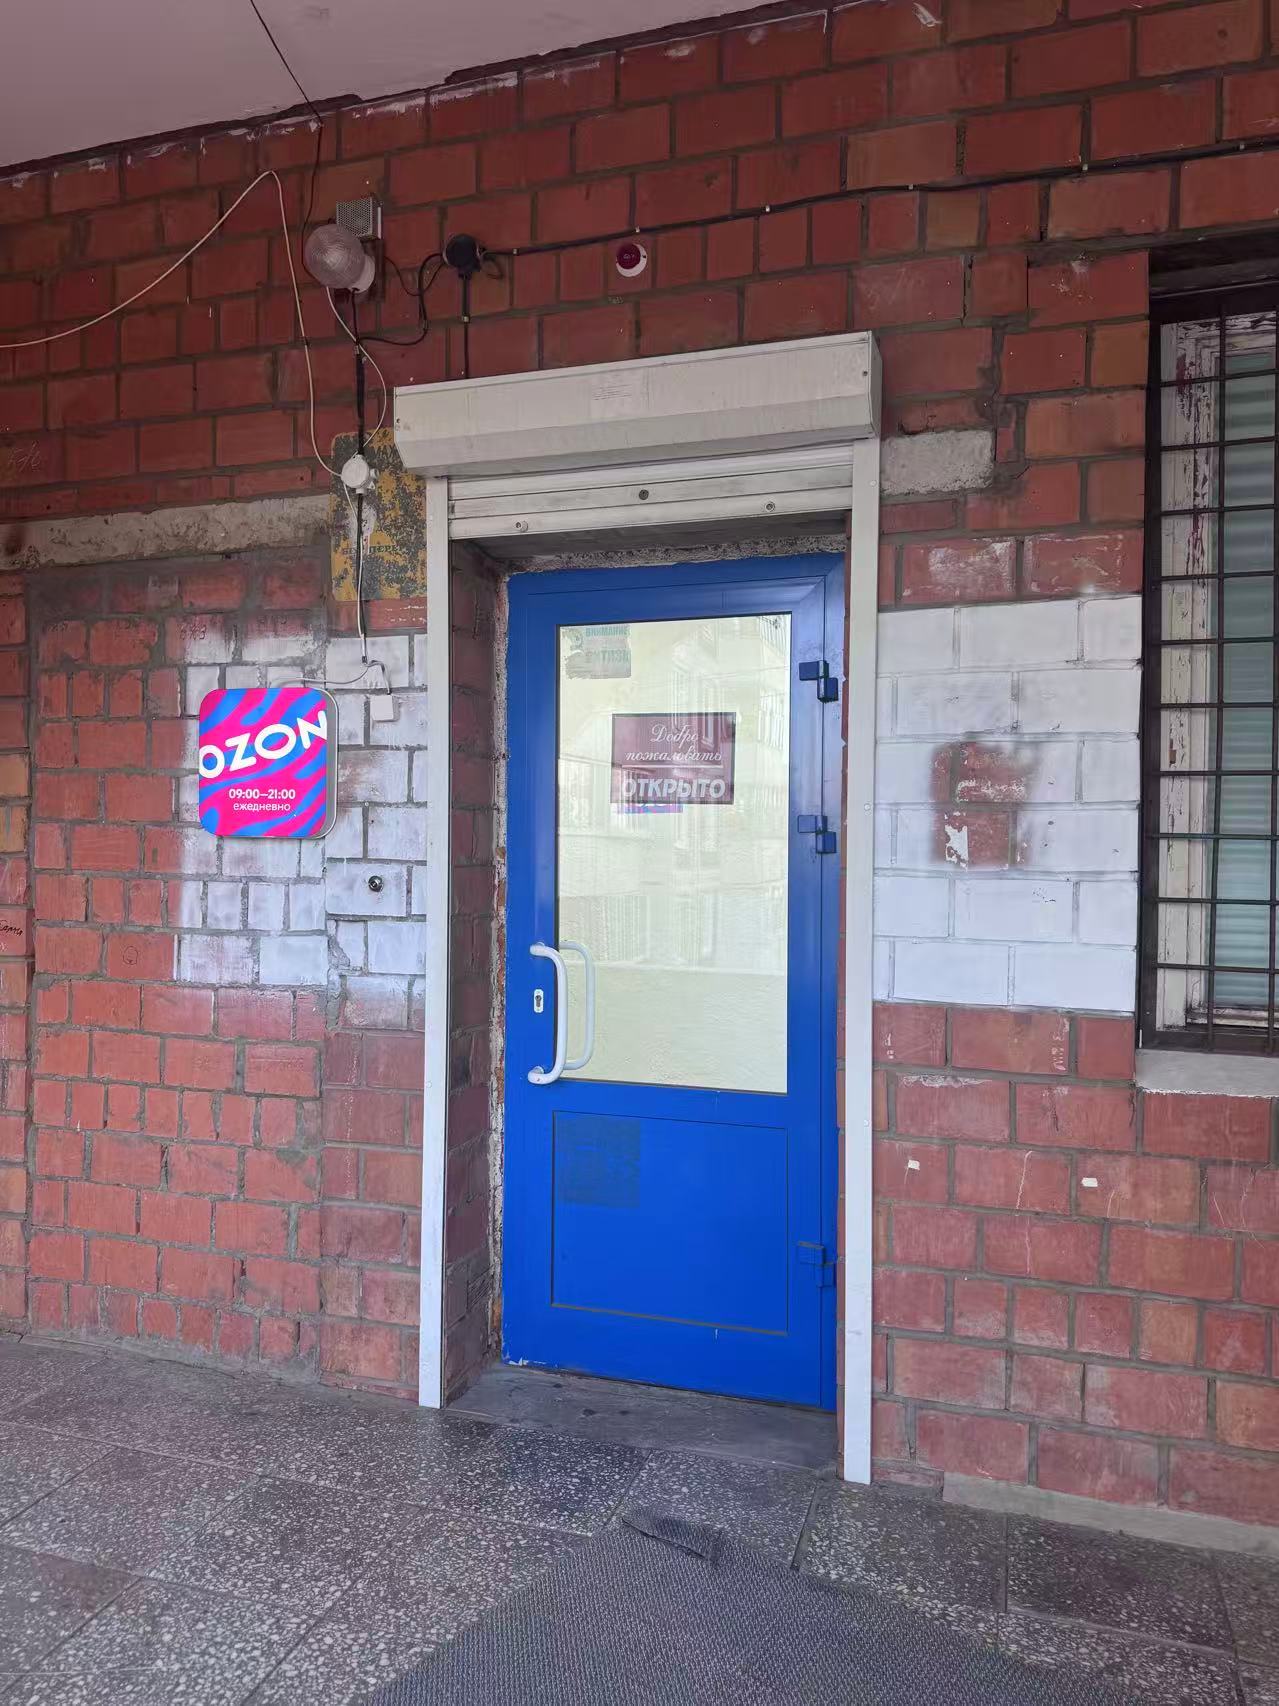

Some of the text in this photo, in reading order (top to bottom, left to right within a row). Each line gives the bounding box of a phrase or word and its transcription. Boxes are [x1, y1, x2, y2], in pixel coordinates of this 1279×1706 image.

[199, 710, 328, 779] OZON
[649, 724, 699, 748] Добро
[625, 745, 723, 761] пожаловать
[621, 778, 726, 799] ОТКРЫТО
[233, 802, 291, 812] ежедневно
